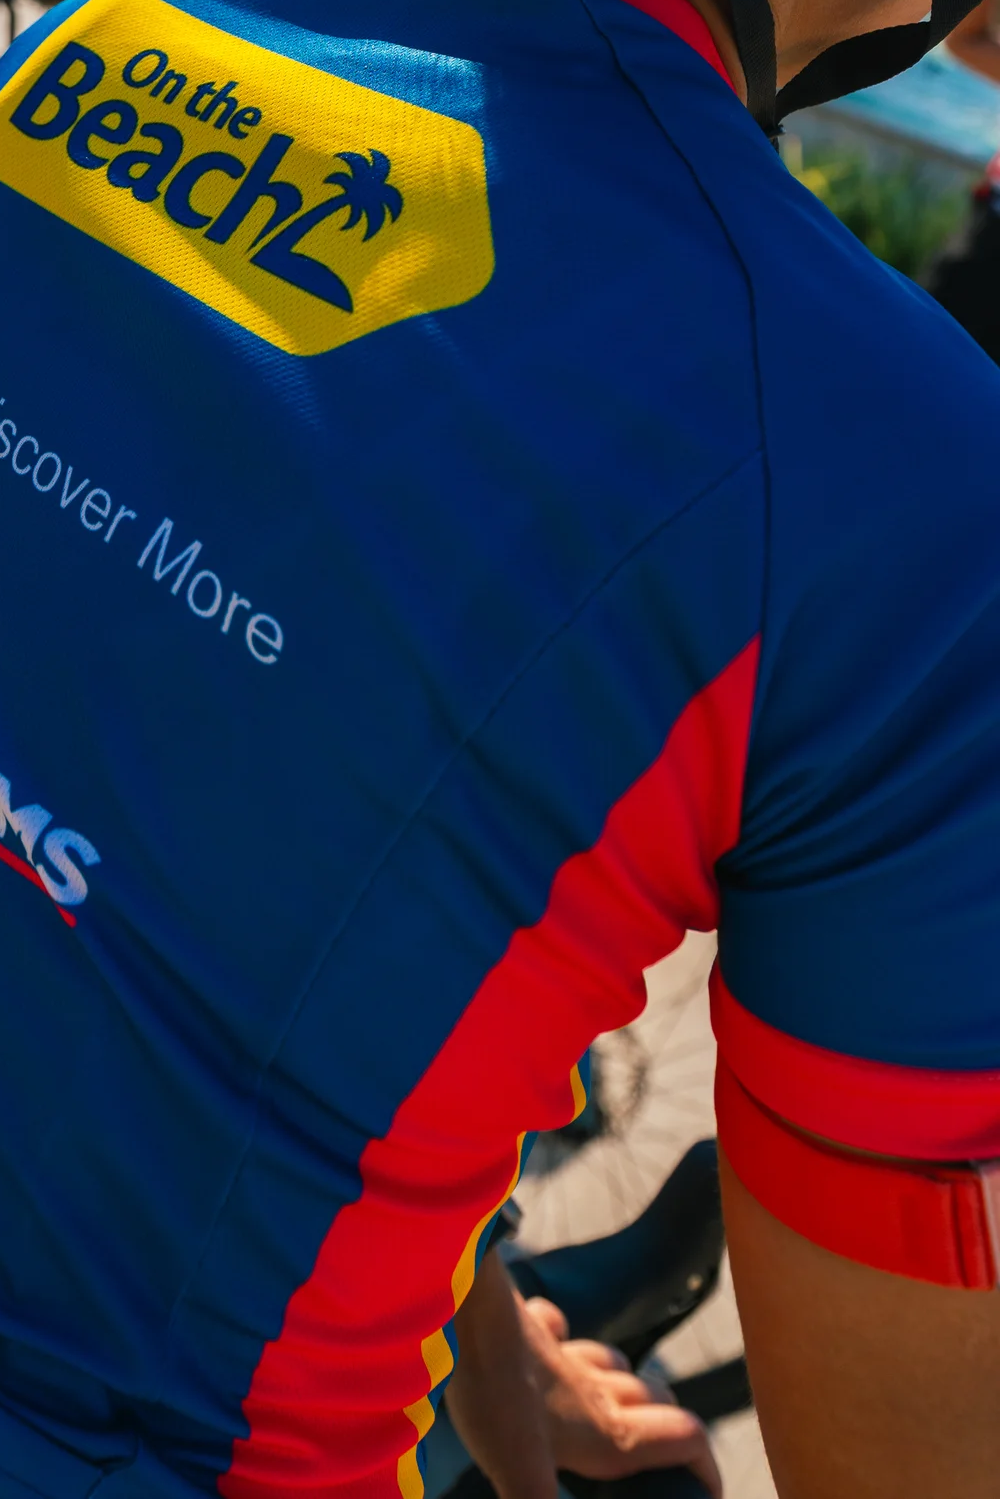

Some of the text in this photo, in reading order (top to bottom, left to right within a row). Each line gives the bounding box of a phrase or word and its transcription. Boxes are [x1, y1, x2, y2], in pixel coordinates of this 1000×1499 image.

[9, 41, 303, 254] Beach
[122, 48, 263, 140] On the
[137, 517, 284, 665] More
